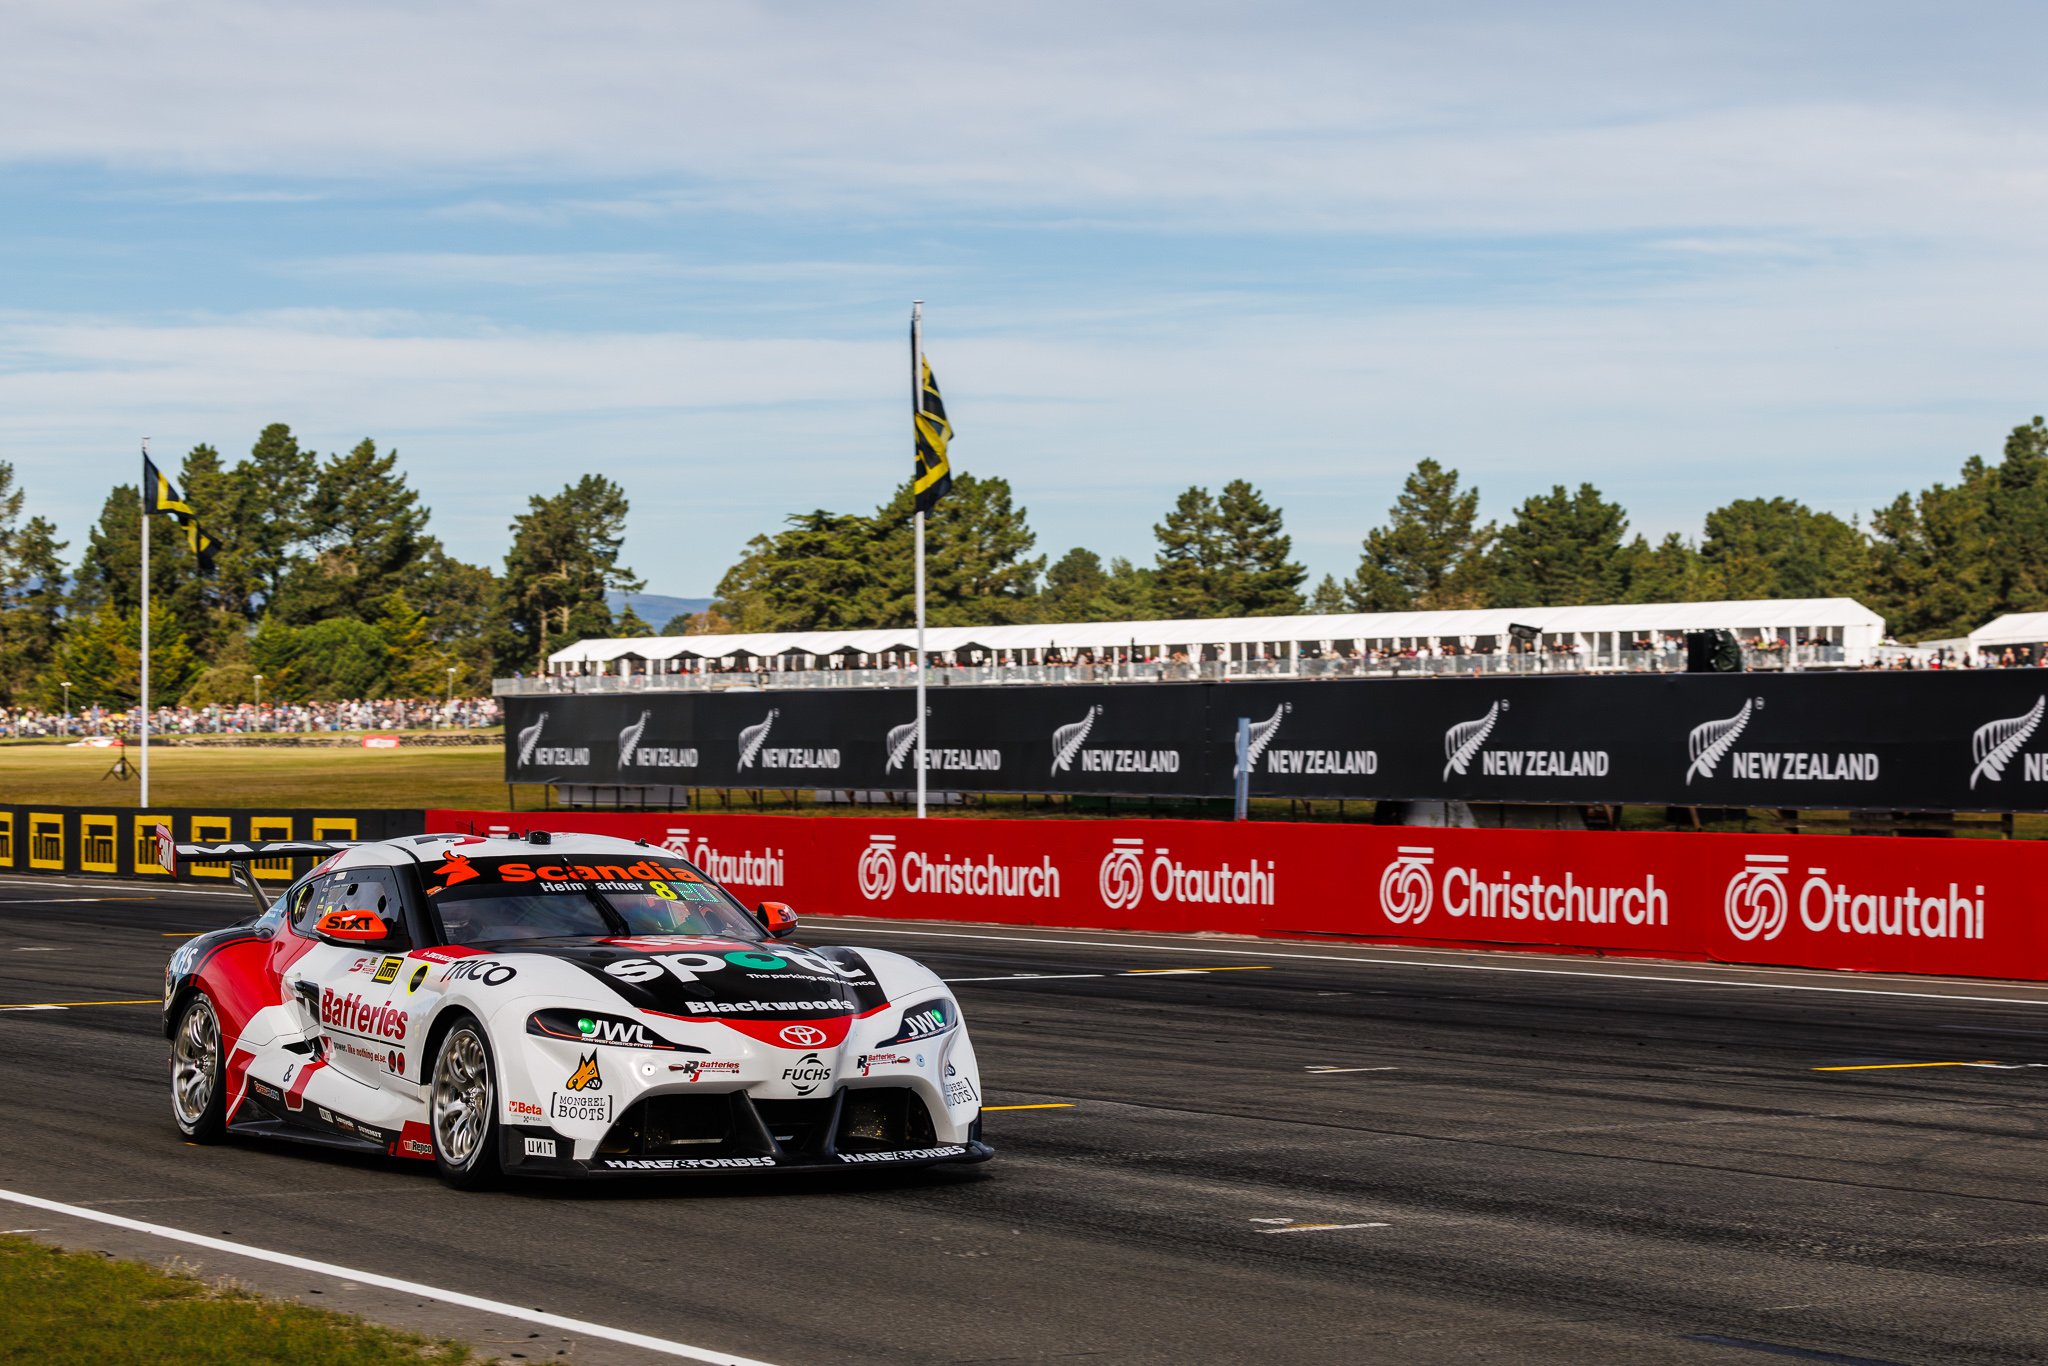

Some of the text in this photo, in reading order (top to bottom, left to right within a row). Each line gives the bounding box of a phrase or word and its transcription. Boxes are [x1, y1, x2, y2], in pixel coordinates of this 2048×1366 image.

[657, 748, 698, 767] ZEALAND
[762, 748, 840, 768] NEW ZEALAND
[943, 749, 1000, 770] ZEALAND
[1082, 750, 1179, 772] NEW ZEALAND
[1268, 750, 1378, 774] NEW ZEALAND
[1482, 751, 1609, 776] NEW ZEALAND
[1732, 753, 1879, 780] NEW ZEALAND
[158, 837, 174, 872] 3M
[498, 860, 704, 883] Scandia
[902, 851, 1060, 898] Christchurch
[1150, 848, 1274, 905] Ōtautahi
[540, 881, 678, 900] Heimartner 8
[1442, 866, 1668, 926] Christchurch
[1800, 867, 1984, 939] Ōtautahi
[440, 960, 517, 986] TRICO
[770, 973, 817, 982] parking
[322, 987, 408, 1040] Batteries
[684, 998, 855, 1015] Blackwoods
[581, 1019, 654, 1044] JWL
[904, 1010, 945, 1037] JWL
[700, 1061, 740, 1069] Batteries
[868, 1053, 896, 1062] Batteries
[781, 1068, 832, 1081] FUCHS
[518, 1101, 542, 1115] Beta
[559, 1096, 606, 1107] MONGREL
[558, 1105, 605, 1121] BOOTS
[412, 1140, 432, 1154] Repco
